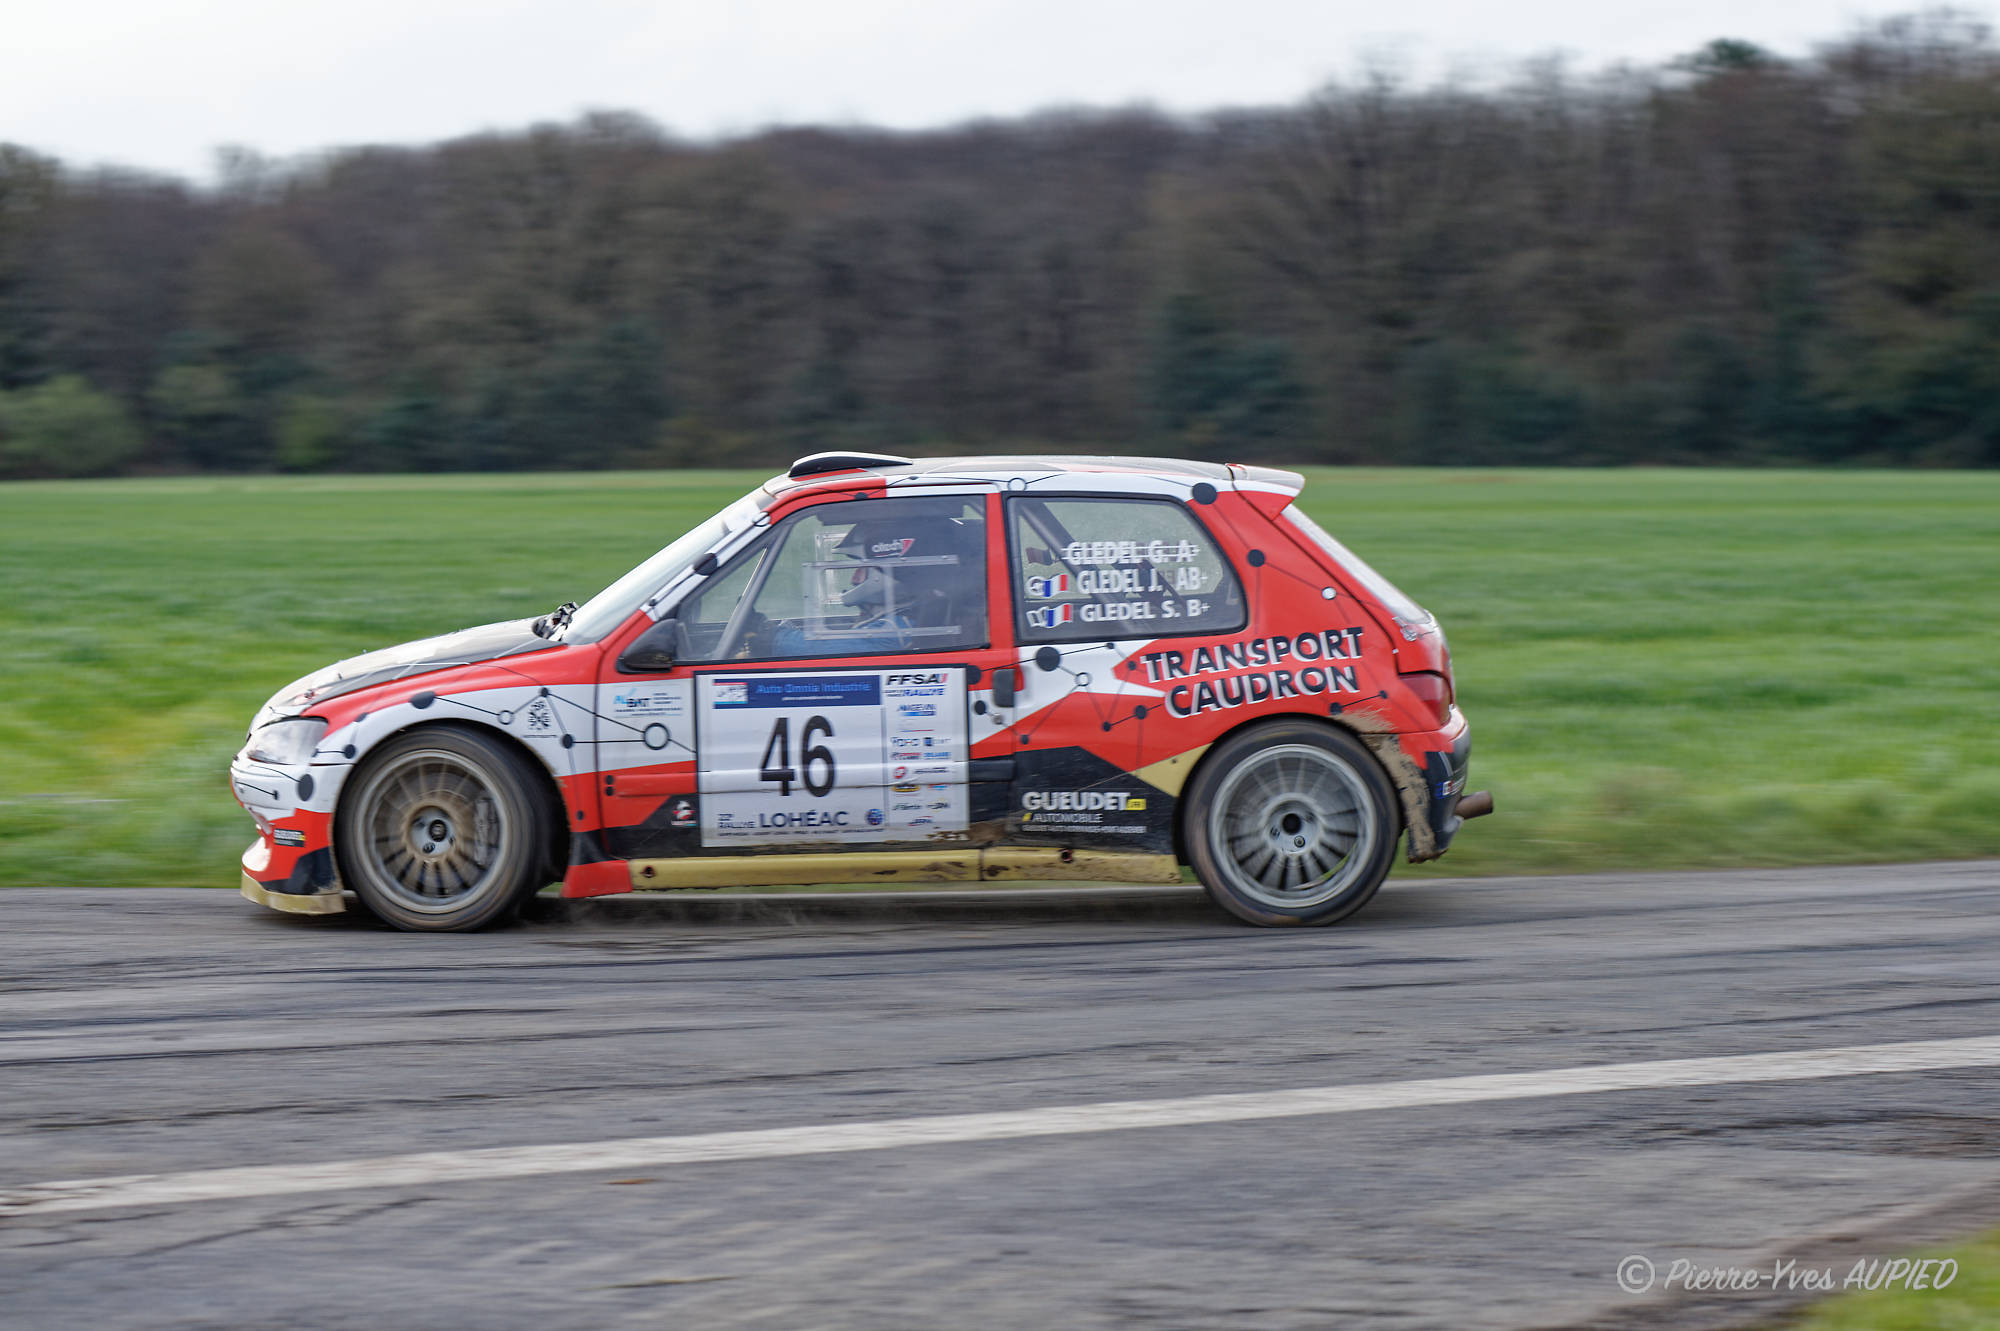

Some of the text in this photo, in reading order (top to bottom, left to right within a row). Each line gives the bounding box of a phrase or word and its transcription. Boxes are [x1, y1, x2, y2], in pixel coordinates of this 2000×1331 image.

[1066, 541, 1143, 565] GLEDEL
[1077, 569, 1145, 594] GLEDEL
[1079, 599, 1211, 622] GLEDEL S. B+
[1140, 627, 1363, 683] TRANSPORT
[755, 684, 782, 694] Auto
[886, 674, 940, 685] FFSA
[1165, 666, 1360, 718] CAUDRON
[760, 715, 836, 797] 46
[1021, 791, 1131, 811] GUEUDET
[759, 809, 849, 828] LOHÉAC
[1032, 813, 1103, 823] AUTOMOBILE
